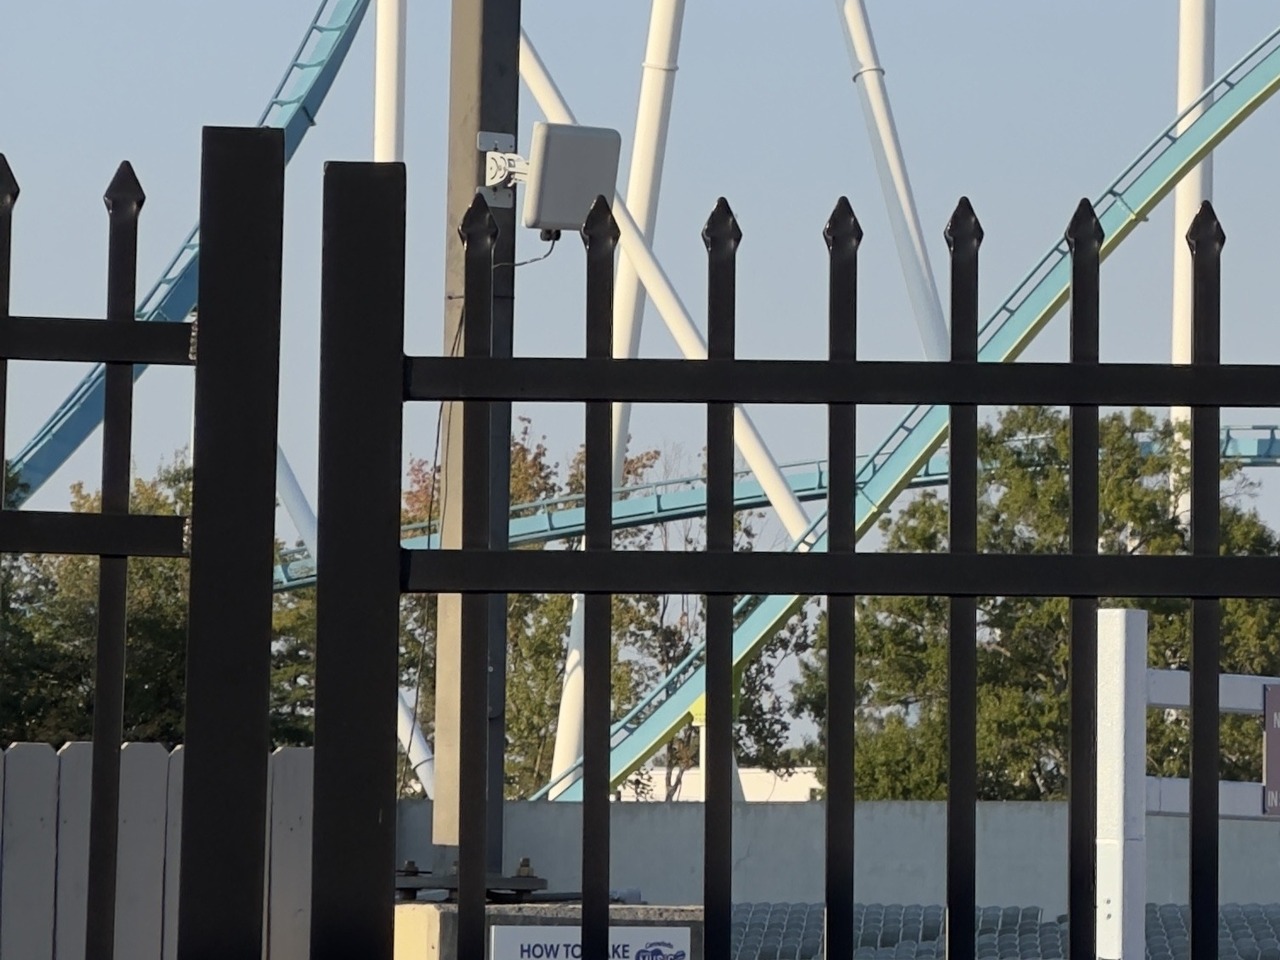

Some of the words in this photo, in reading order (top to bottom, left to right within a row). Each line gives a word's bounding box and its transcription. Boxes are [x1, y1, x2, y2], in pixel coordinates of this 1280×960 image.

[1267, 790, 1278, 808] IN
[520, 943, 560, 959] HOW
[564, 943, 582, 959] TO
